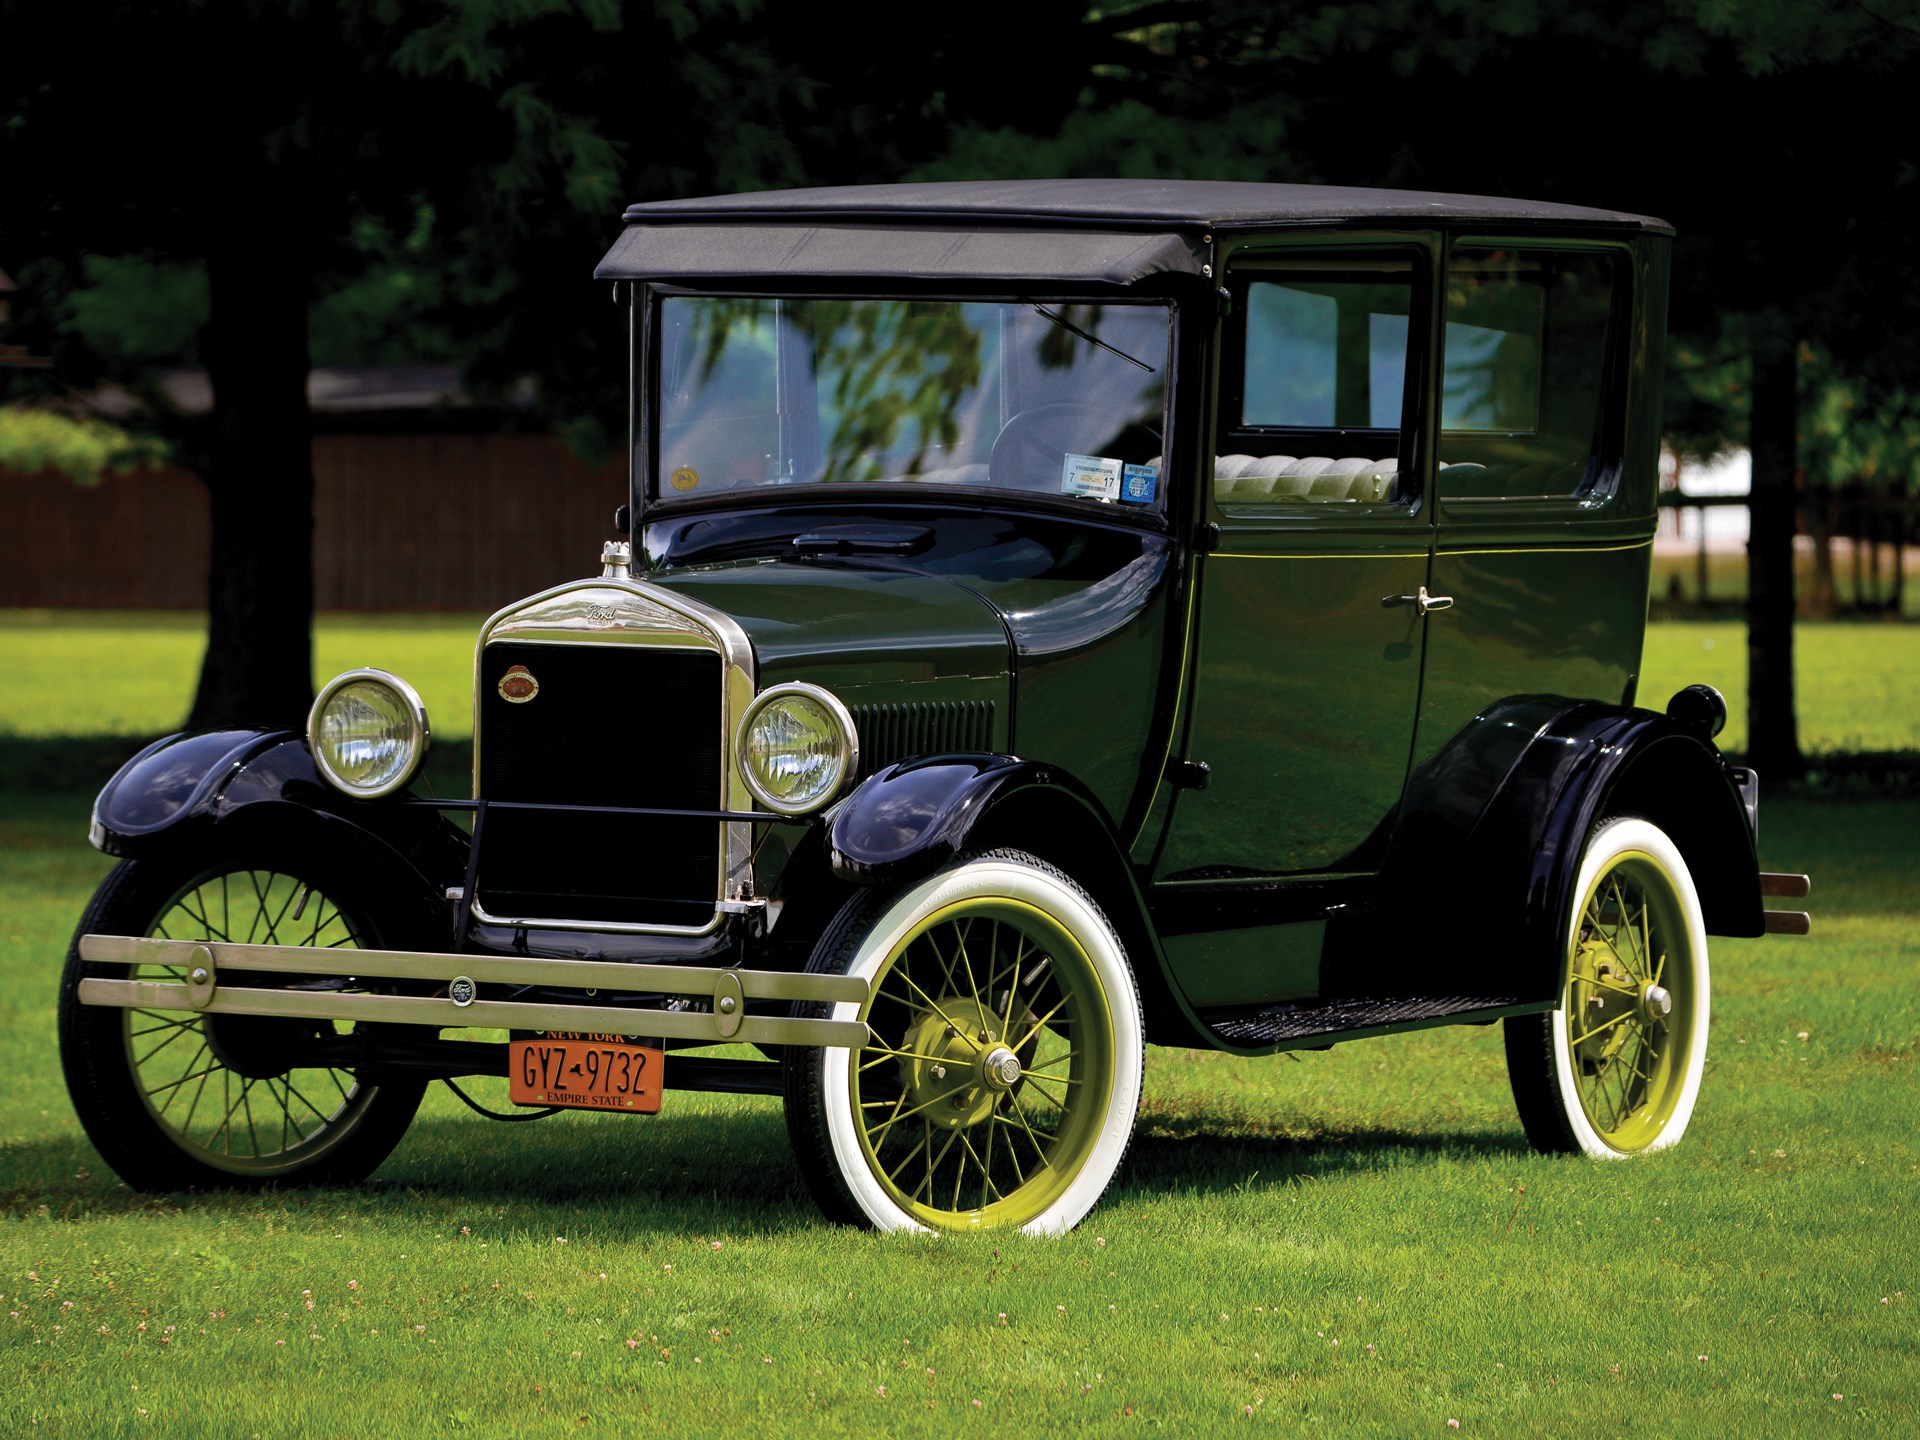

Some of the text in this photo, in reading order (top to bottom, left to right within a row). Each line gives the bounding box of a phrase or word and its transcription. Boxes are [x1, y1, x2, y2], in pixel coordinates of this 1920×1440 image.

[1069, 472, 1075, 483] 7
[1104, 477, 1115, 488] 17
[586, 604, 616, 620] Ford
[453, 983, 471, 993] Ford
[547, 1031, 625, 1044] NEW YORK
[523, 1046, 647, 1095] GYZ 9732
[547, 1092, 625, 1107] EMPIRE STATE
